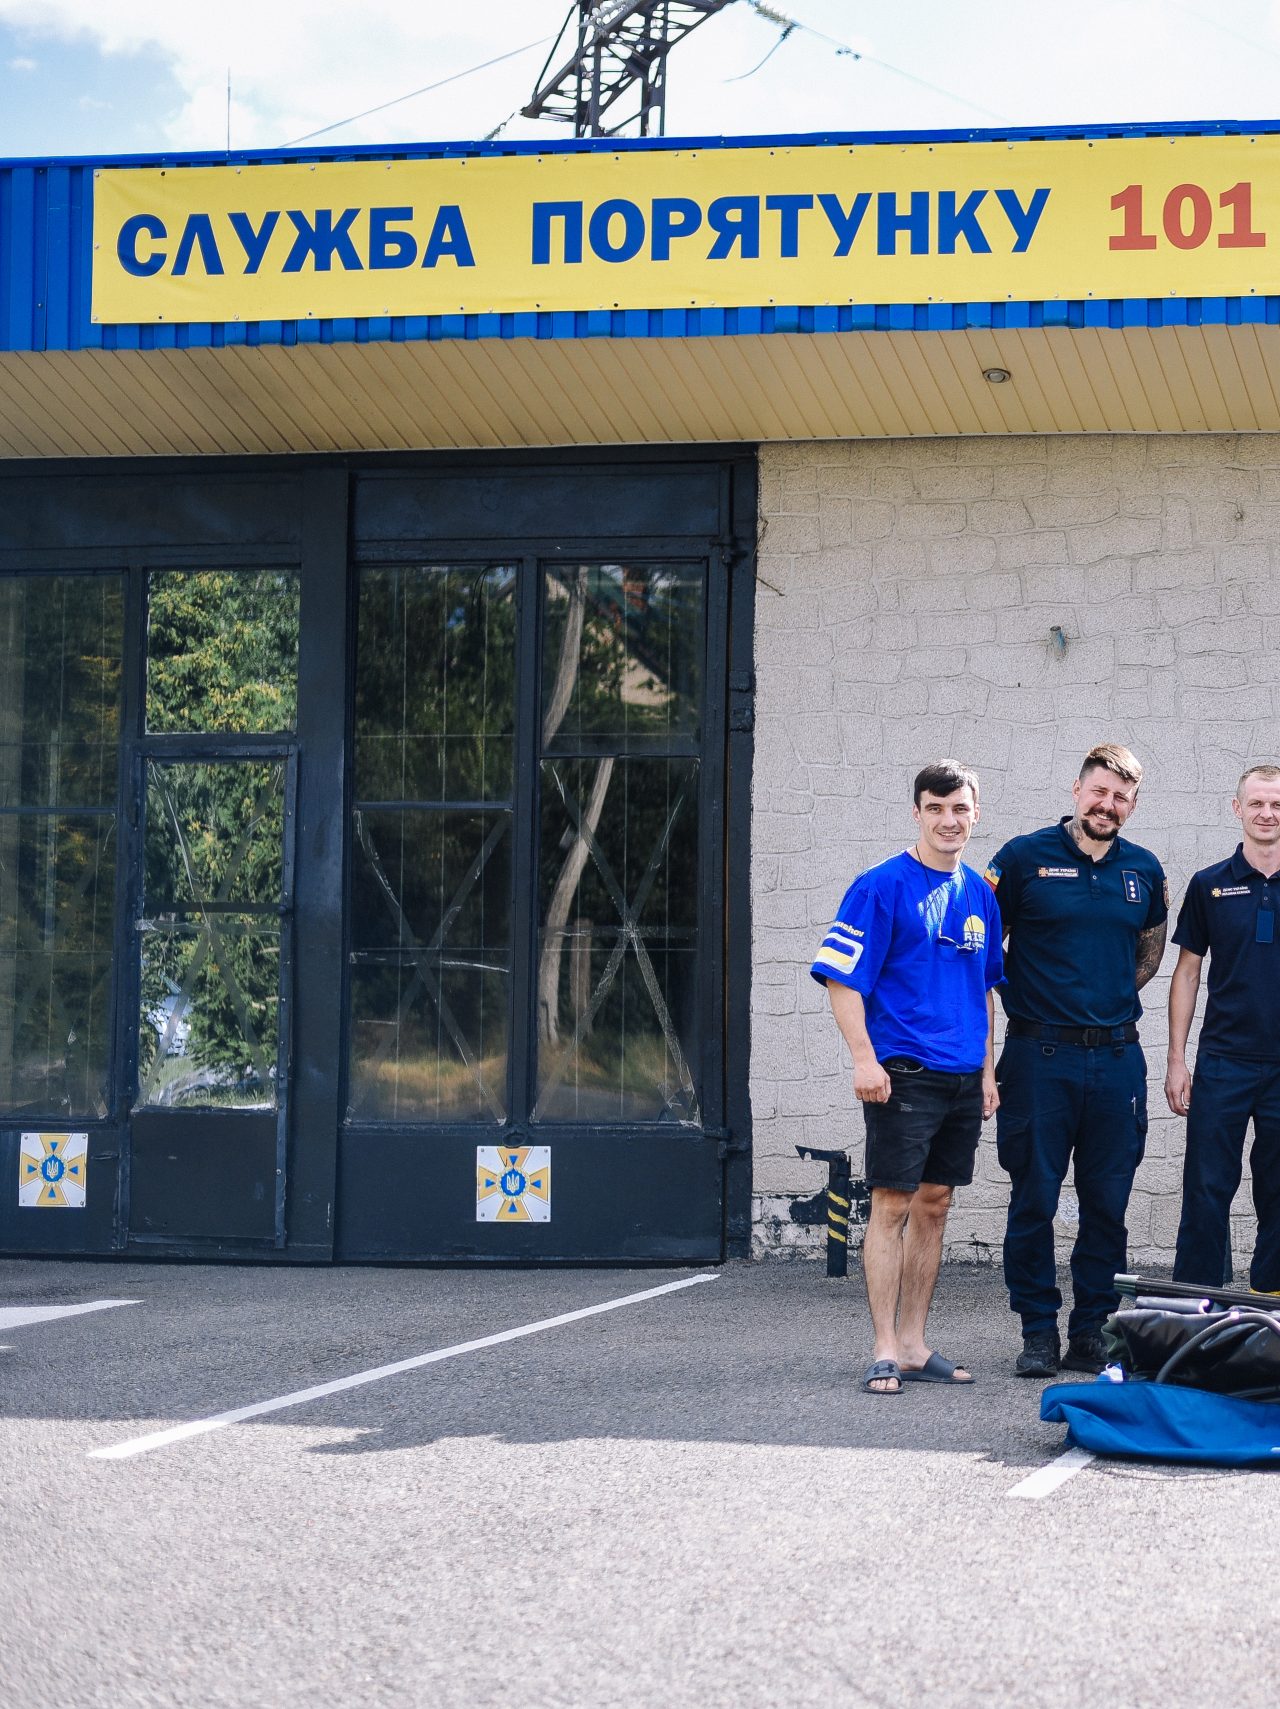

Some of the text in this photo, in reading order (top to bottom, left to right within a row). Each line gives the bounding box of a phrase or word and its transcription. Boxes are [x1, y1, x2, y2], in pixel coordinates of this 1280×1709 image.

[117, 204, 476, 278] СЛУЖБА
[531, 188, 1052, 265] ПОРЯТУНКУ
[1108, 182, 1267, 251] 101
